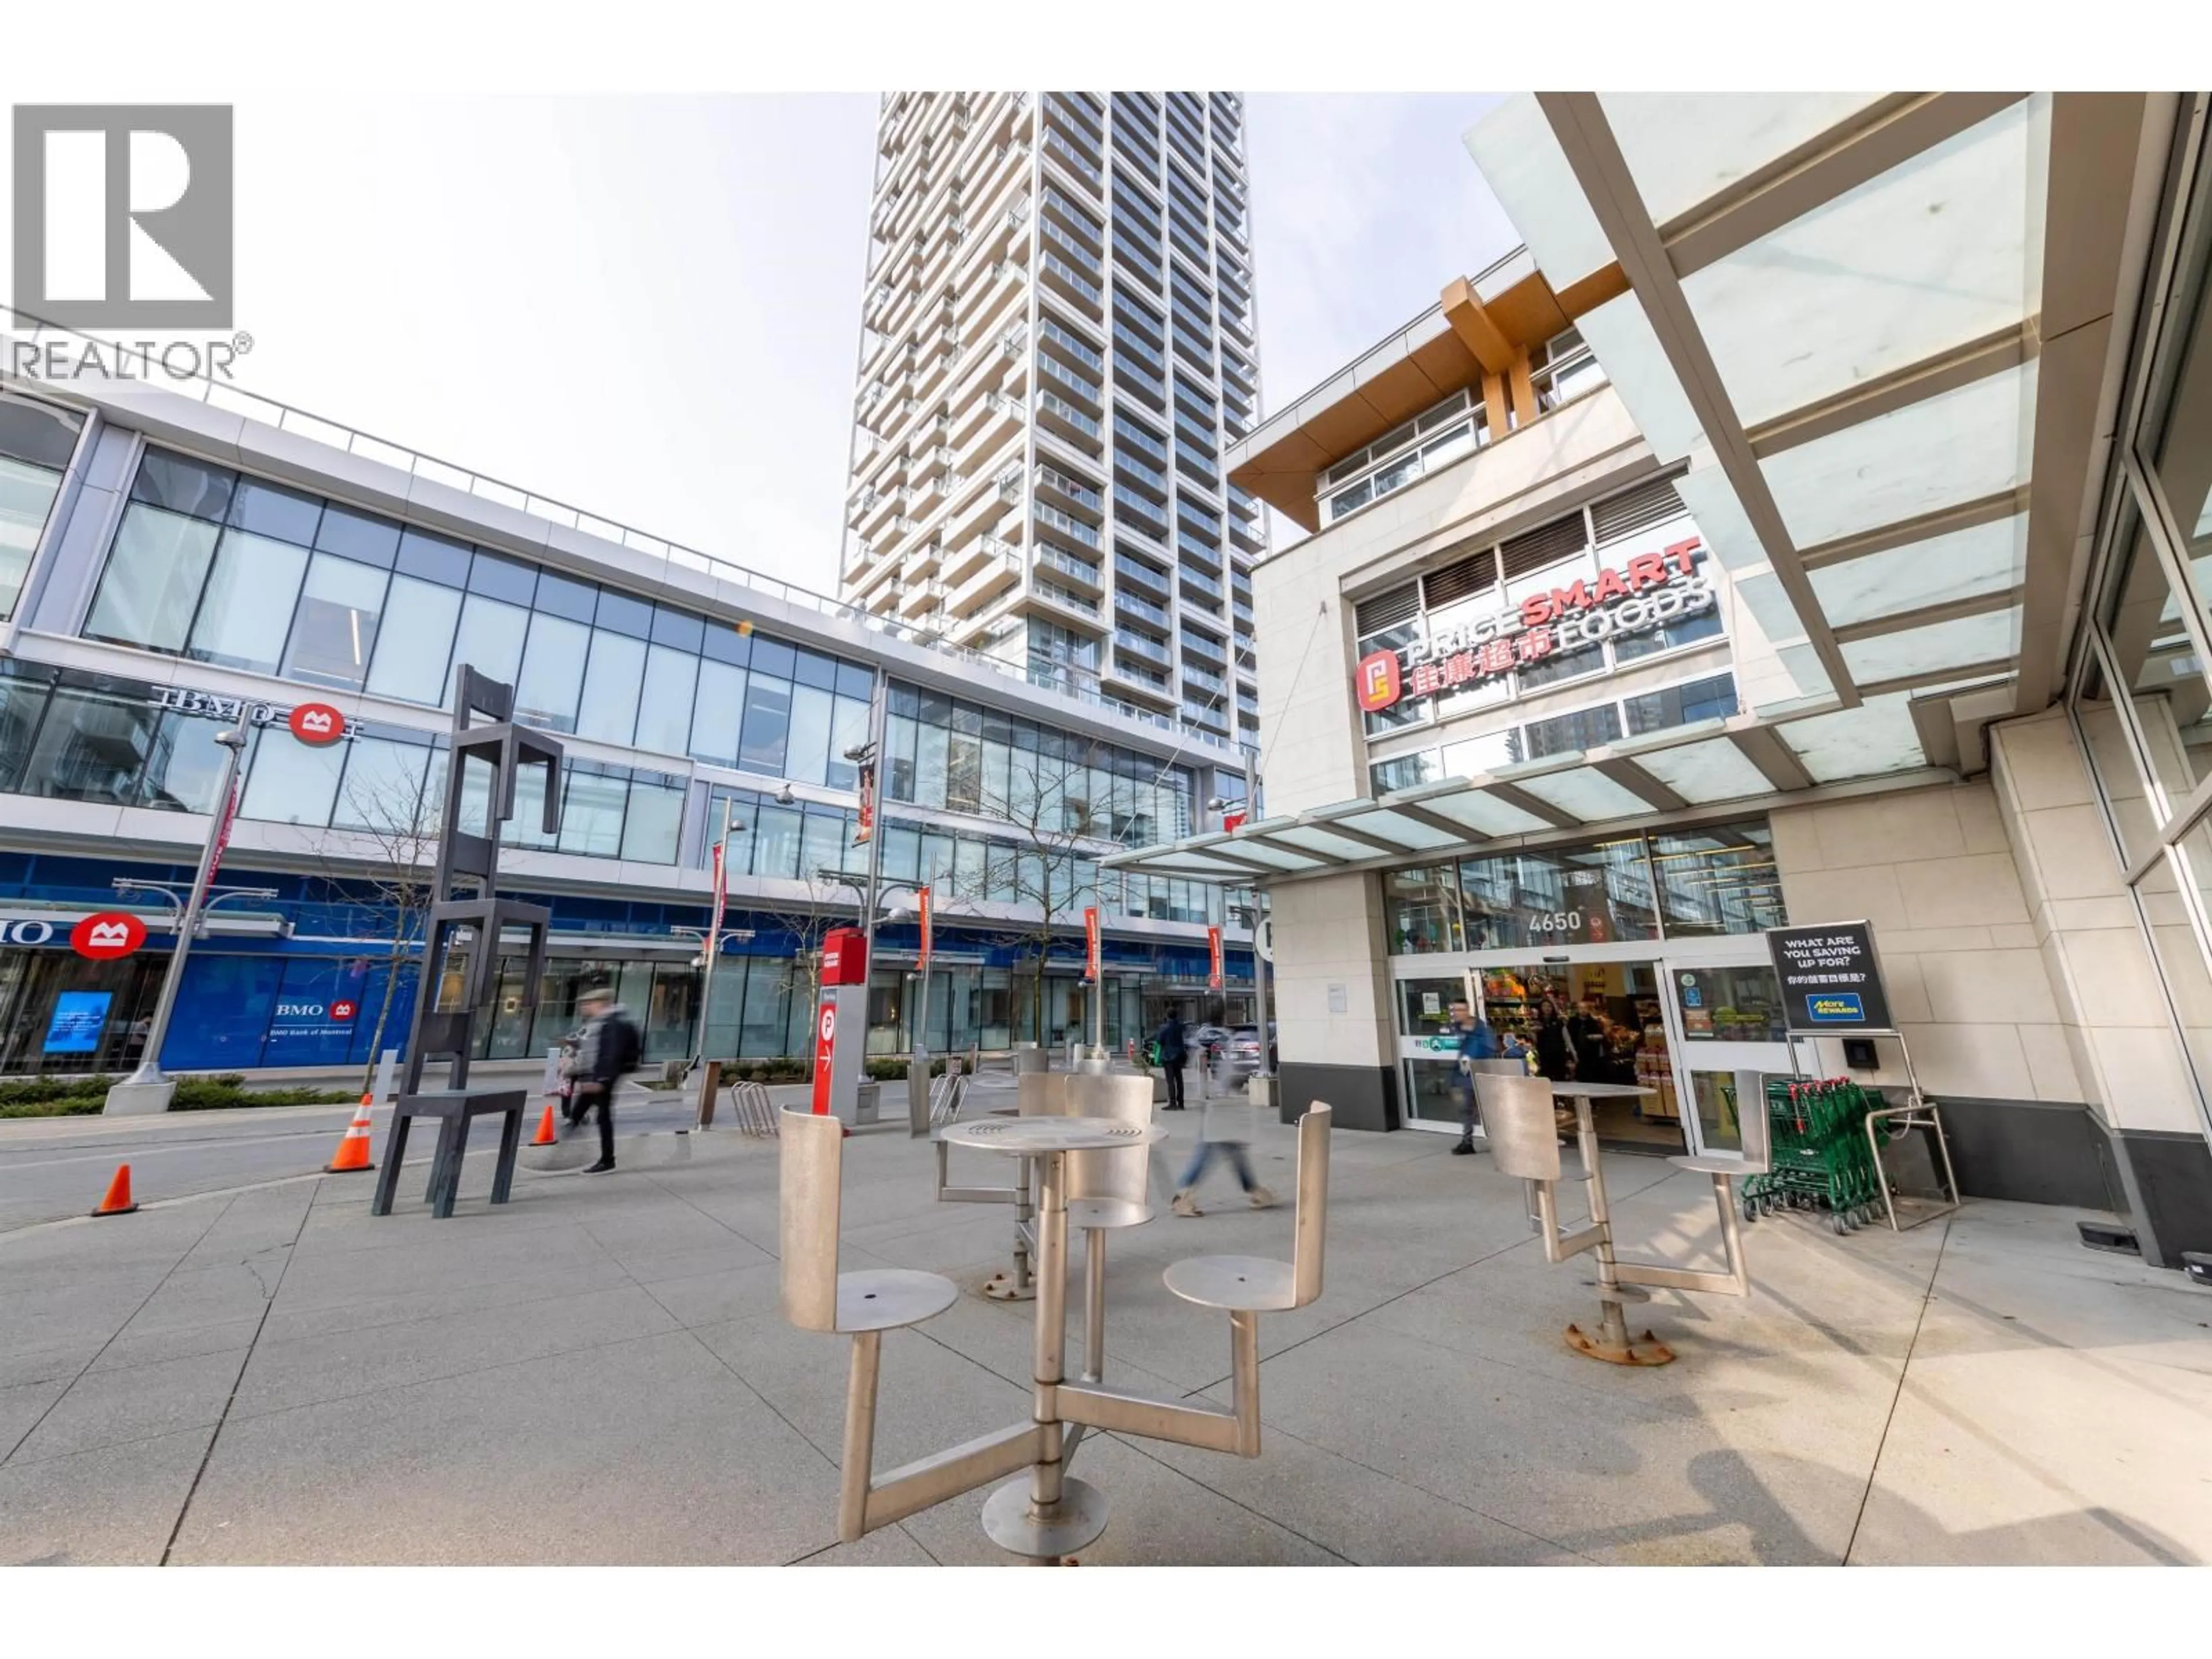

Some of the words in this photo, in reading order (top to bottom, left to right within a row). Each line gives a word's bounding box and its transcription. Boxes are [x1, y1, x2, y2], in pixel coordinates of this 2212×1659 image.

[1558, 574, 1715, 649] FOODS
[1529, 911, 1581, 932] 4650
[1785, 938, 1824, 948] WHAT
[1827, 936, 1854, 945] ARE
[1783, 949, 1811, 959] YOU
[1812, 946, 1861, 956] SAVING
[1797, 959, 1815, 968] UP
[1818, 956, 1851, 967] FOR?
[276, 1005, 323, 1016] BMO
[1814, 1000, 1844, 1009] More
